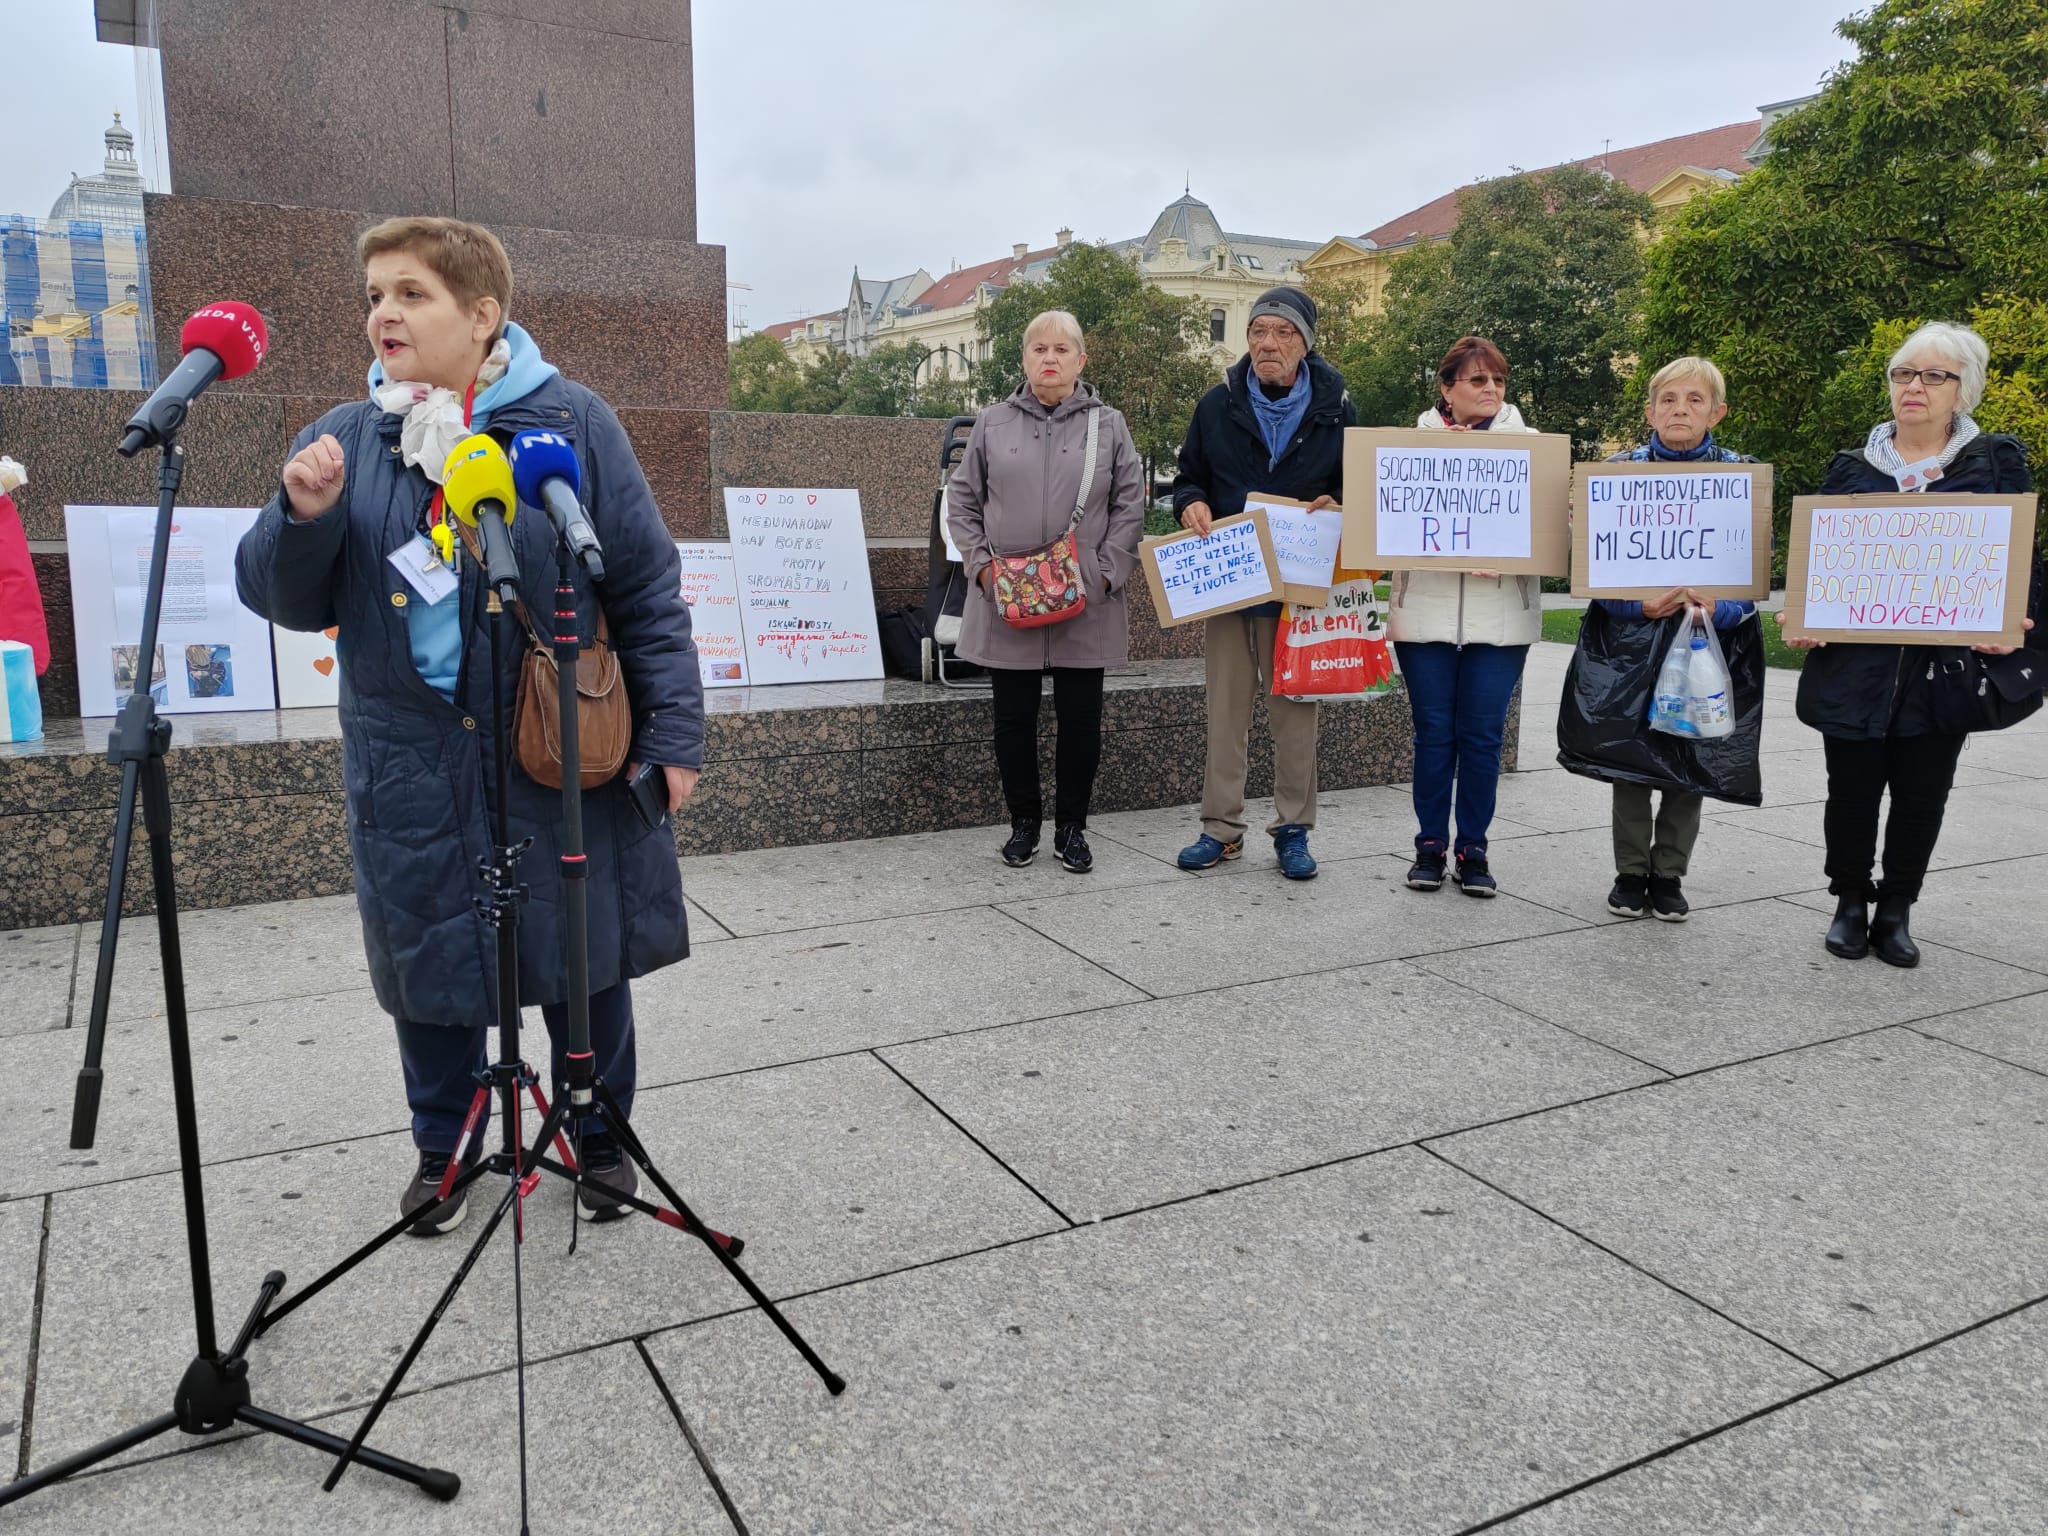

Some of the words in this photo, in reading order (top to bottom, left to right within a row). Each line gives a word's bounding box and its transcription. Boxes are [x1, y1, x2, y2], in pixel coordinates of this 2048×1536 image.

[107, 272, 138, 281] Cemix
[41, 282, 73, 293] Cemix
[193, 309, 236, 321] VIDA
[1379, 456, 1462, 482] SOCIJALNA
[1467, 458, 1528, 484] PRAVDA
[777, 494, 794, 504] DO
[1380, 486, 1500, 514] NEPOZNANICA
[1508, 489, 1521, 514] U
[1591, 481, 1613, 502] EU
[1269, 518, 1295, 531] TEDE
[1816, 513, 1837, 538] MI
[1840, 512, 1883, 538] SMO
[1886, 512, 1987, 538] ODRADILI
[774, 535, 824, 550] BORBE
[1157, 522, 1255, 562] DOSTOJANSTVO
[1595, 530, 1617, 561] MI
[1627, 528, 1716, 560] SLUGE
[782, 558, 826, 572] PROTIV
[1175, 554, 1196, 570] STE
[1925, 544, 1942, 570] A
[1218, 563, 1222, 572] I
[747, 572, 831, 591] SIROMAŠTVA
[1192, 571, 1238, 595] ŽIVOTE
[1807, 573, 1928, 604] BOGATITE
[1930, 570, 2003, 608] NAŠIM
[1367, 610, 1380, 632] 2
[1311, 656, 1364, 671] KONZUM
